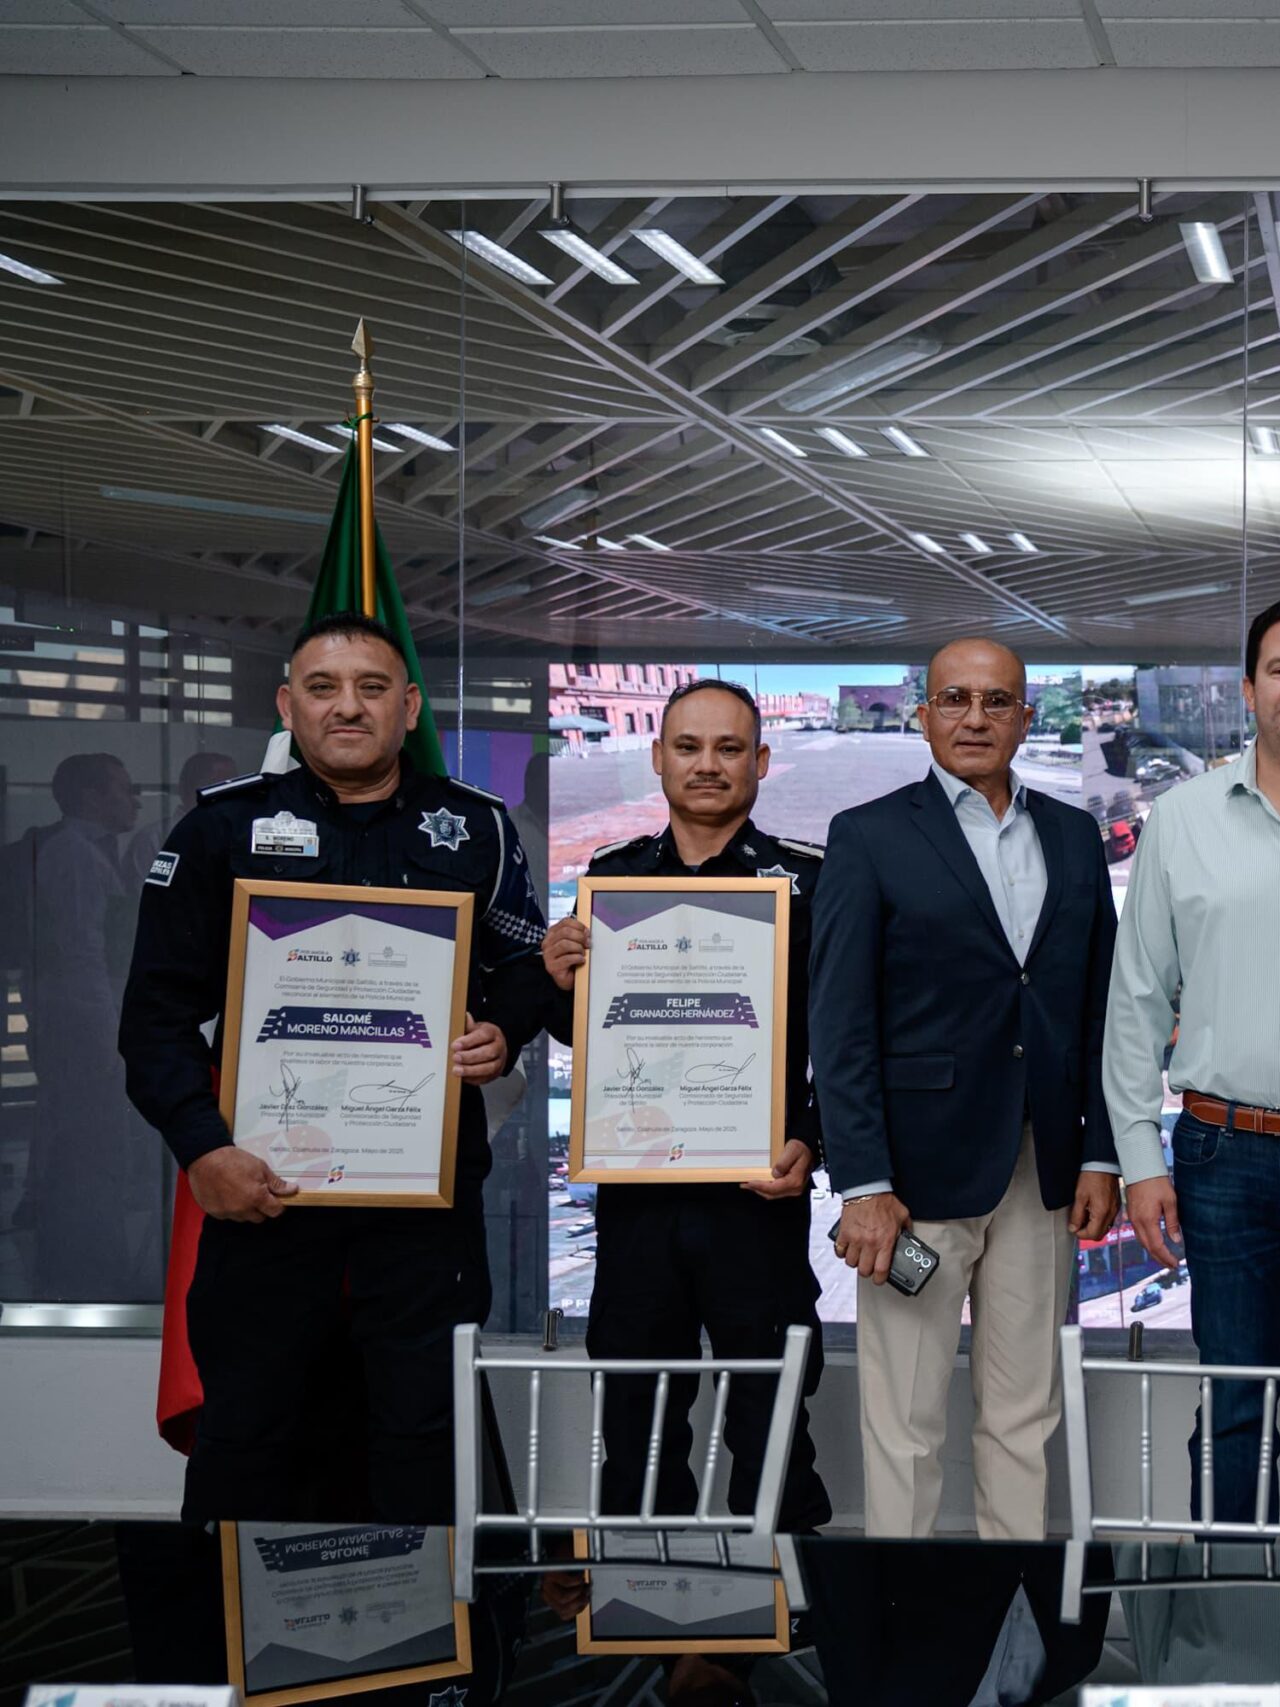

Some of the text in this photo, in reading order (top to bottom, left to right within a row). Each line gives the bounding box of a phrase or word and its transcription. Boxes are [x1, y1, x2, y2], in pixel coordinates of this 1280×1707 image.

[287, 949, 333, 963] SALTILLO
[667, 999, 701, 1008] FELIPE
[323, 1012, 372, 1024] SALOMÉ
[630, 1008, 735, 1018] GRANADOS HERNÁNDEZ
[287, 1024, 405, 1037] MORENO MANCILLAS
[341, 1105, 363, 1113] Miguel
[365, 1105, 384, 1114] Ángel
